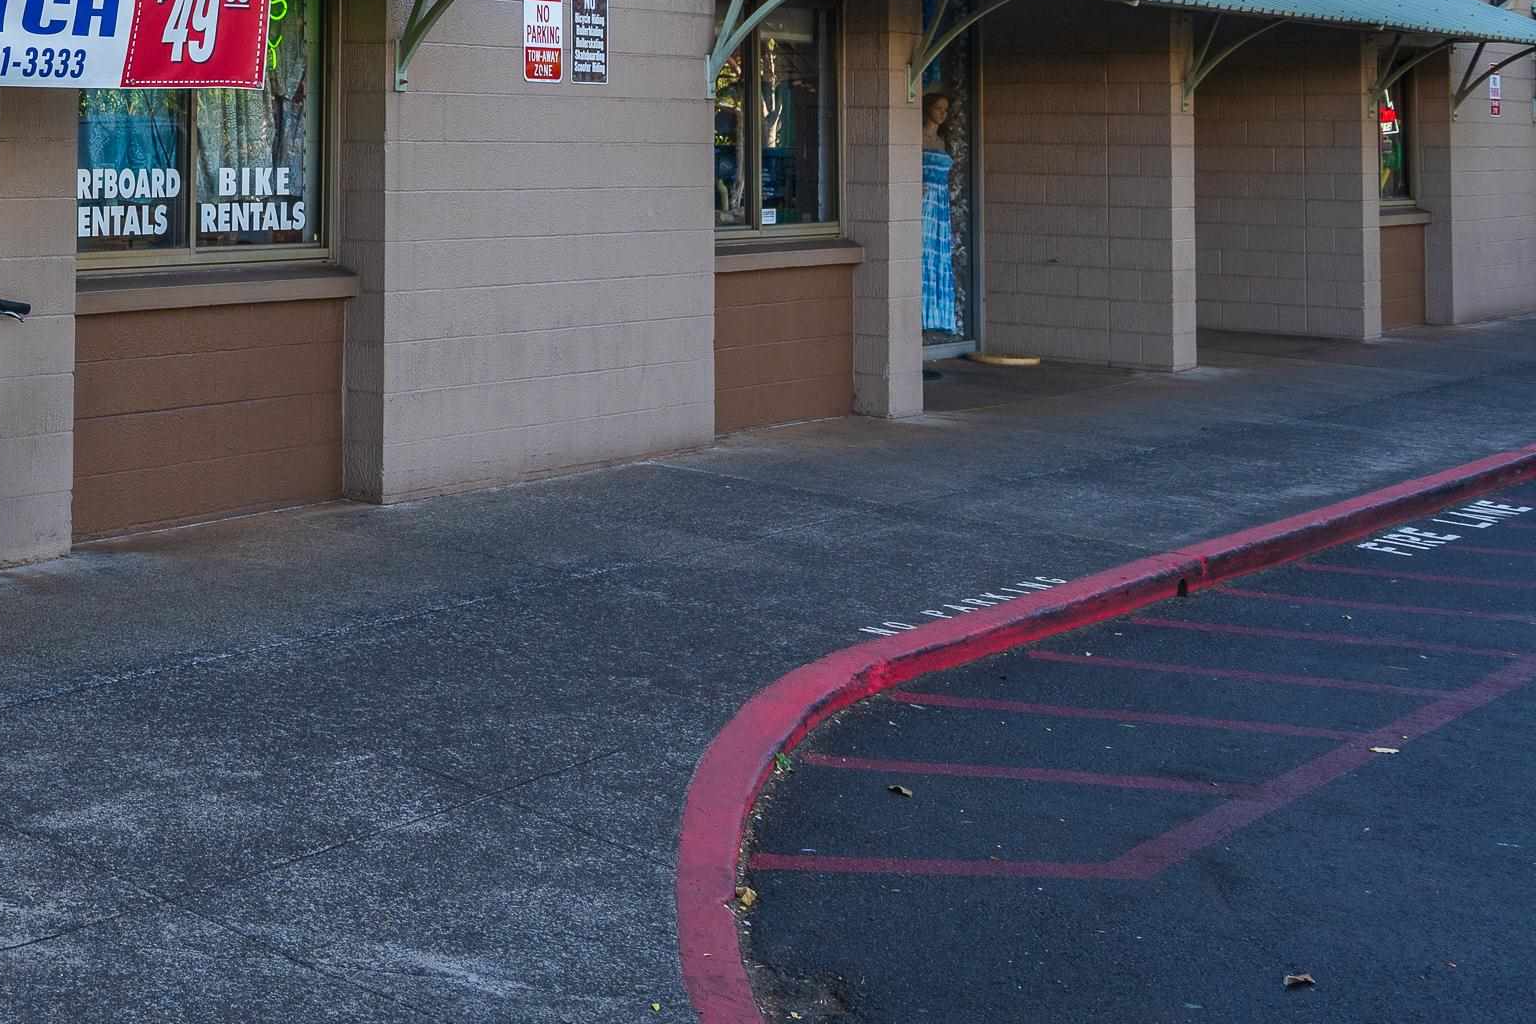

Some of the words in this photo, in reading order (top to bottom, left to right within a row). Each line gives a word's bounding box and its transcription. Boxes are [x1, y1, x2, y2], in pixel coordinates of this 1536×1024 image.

[536, 5, 550, 23] NO
[527, 25, 560, 44] PARKING
[528, 50, 559, 63] TOW-AWAY
[534, 64, 552, 76] ZONE
[219, 167, 290, 196] BIKE
[200, 201, 306, 233] RENTALS
[1357, 527, 1461, 556] FIRE
[1432, 500, 1533, 528] LANE
[859, 621, 917, 636] NO
[920, 576, 1068, 618] PARKING
